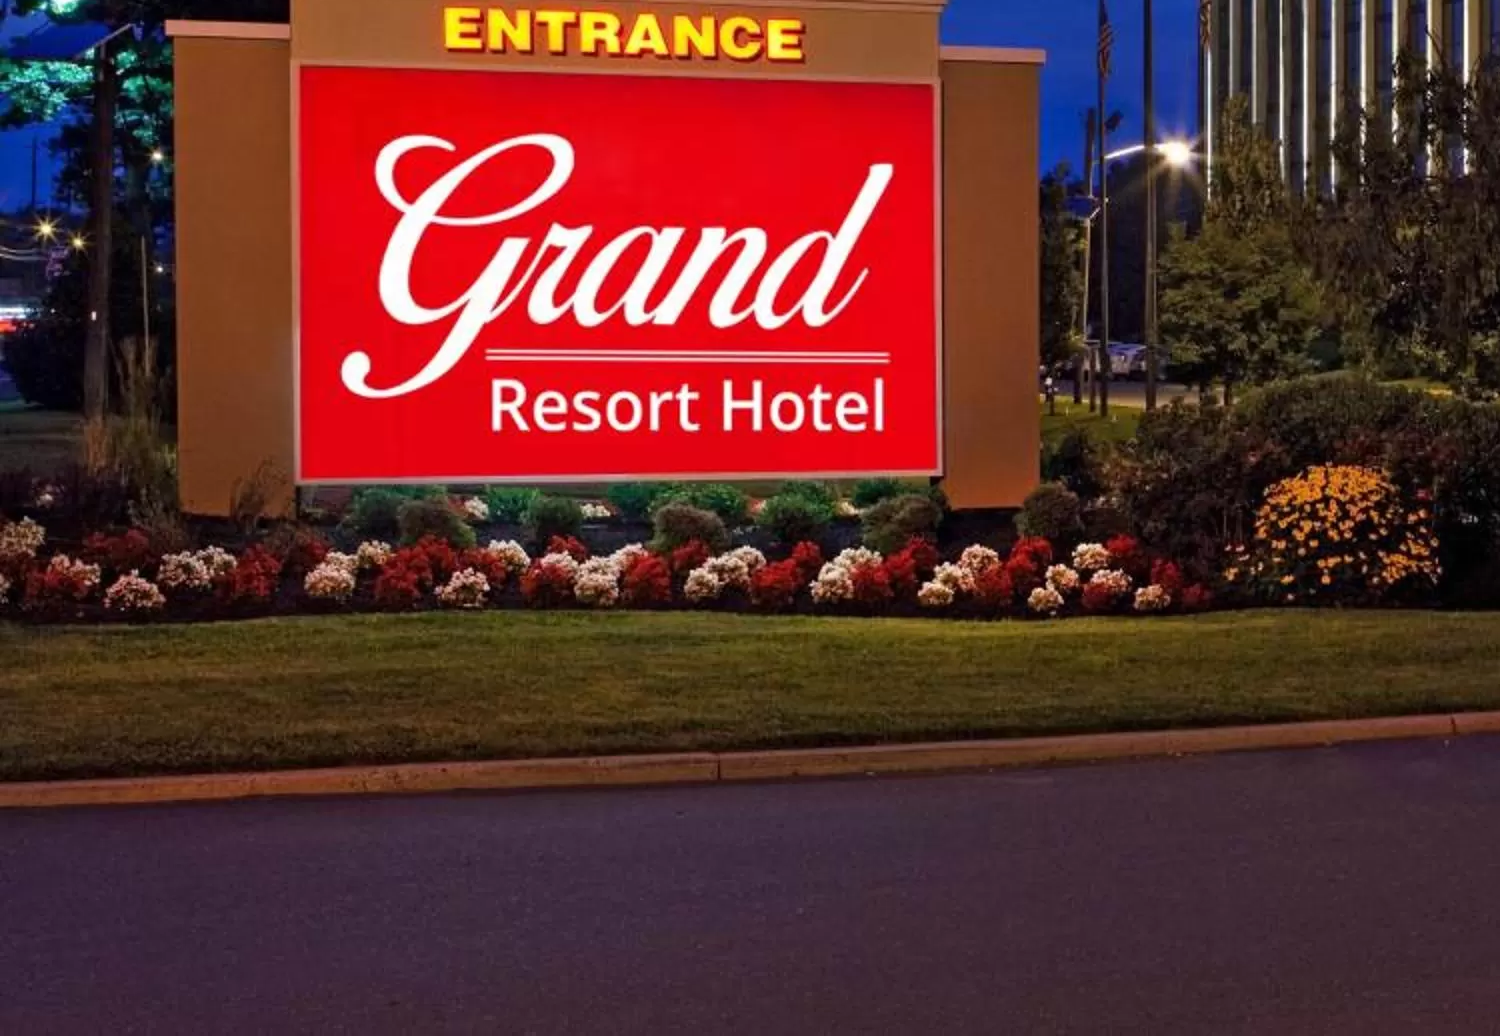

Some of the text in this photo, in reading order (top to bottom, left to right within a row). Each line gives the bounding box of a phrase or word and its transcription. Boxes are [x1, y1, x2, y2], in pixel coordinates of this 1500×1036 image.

[443, 6, 805, 61] ENTRANCE
[341, 133, 893, 398] Grand
[491, 378, 885, 432] Resort Hotel
